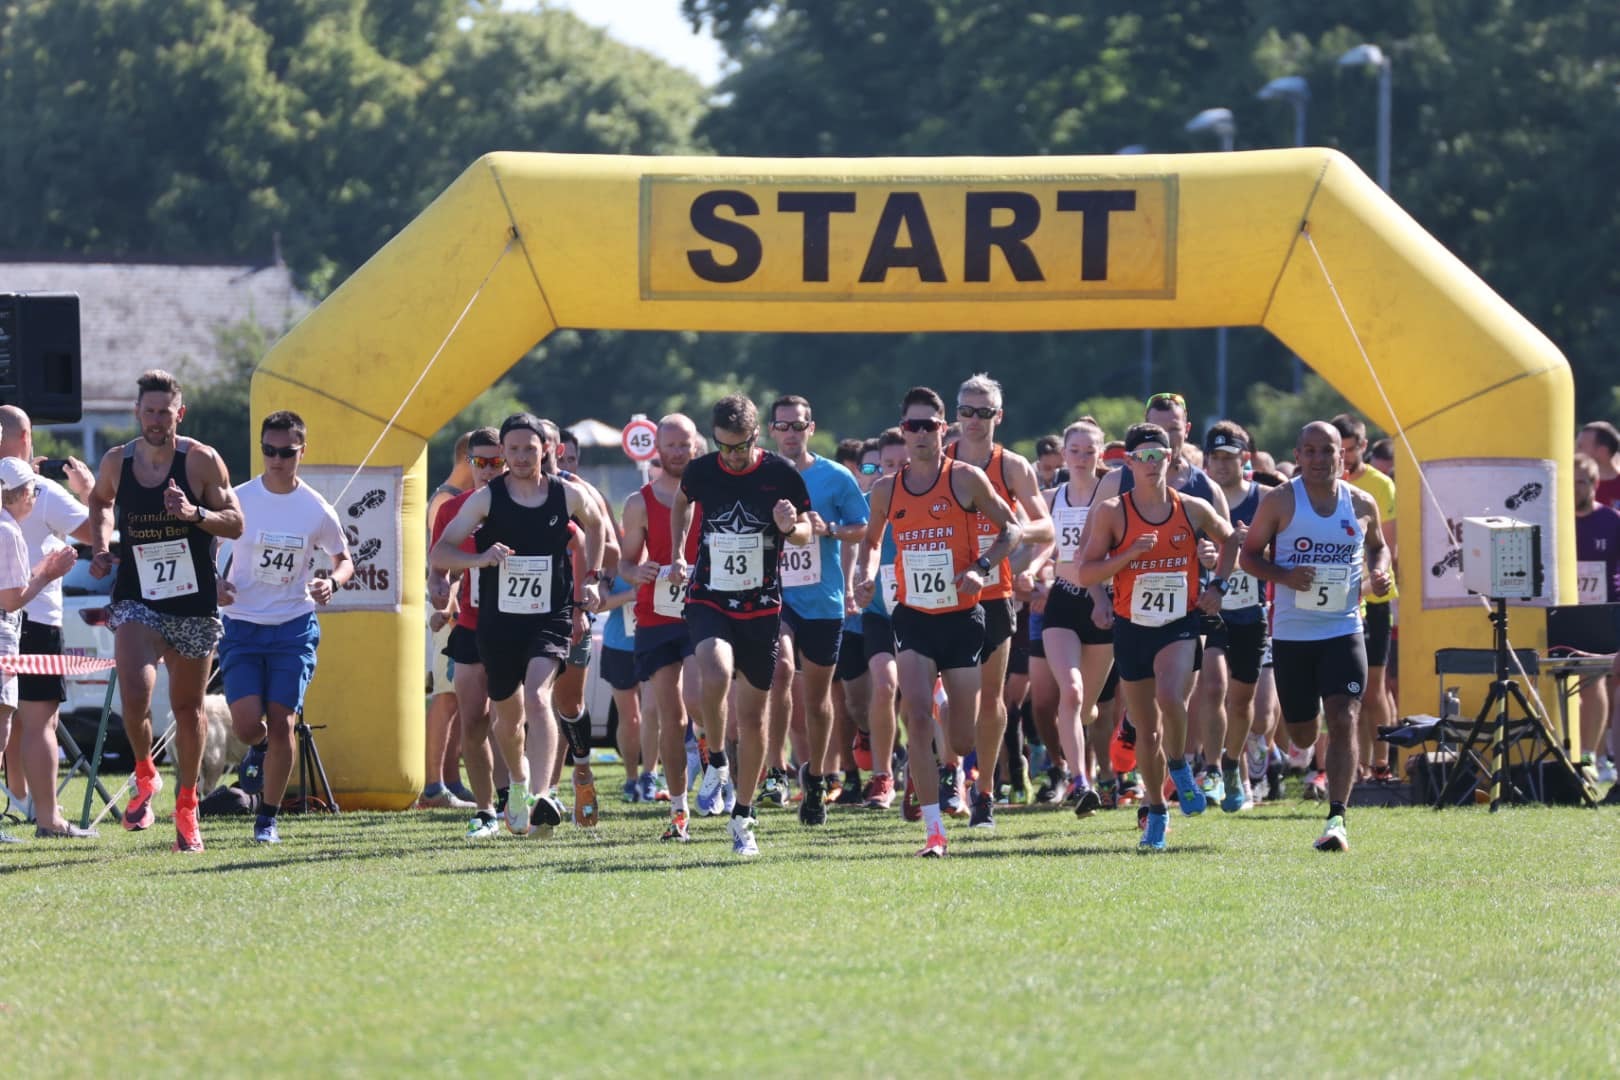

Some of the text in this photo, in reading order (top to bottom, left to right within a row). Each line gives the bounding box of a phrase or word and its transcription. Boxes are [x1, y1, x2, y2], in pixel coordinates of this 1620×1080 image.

[687, 190, 1136, 283] START
[630, 433, 651, 448] 45
[898, 527, 953, 541] WESTERN
[260, 549, 295, 572] 544
[724, 555, 747, 575] 43
[781, 551, 812, 571] 403
[1130, 556, 1188, 569] WESTERN
[1288, 553, 1311, 564] AIR
[154, 560, 177, 583] 27
[508, 577, 542, 597] 276
[913, 573, 945, 593] 126
[1141, 591, 1174, 613] 241
[1317, 586, 1328, 606] 5
